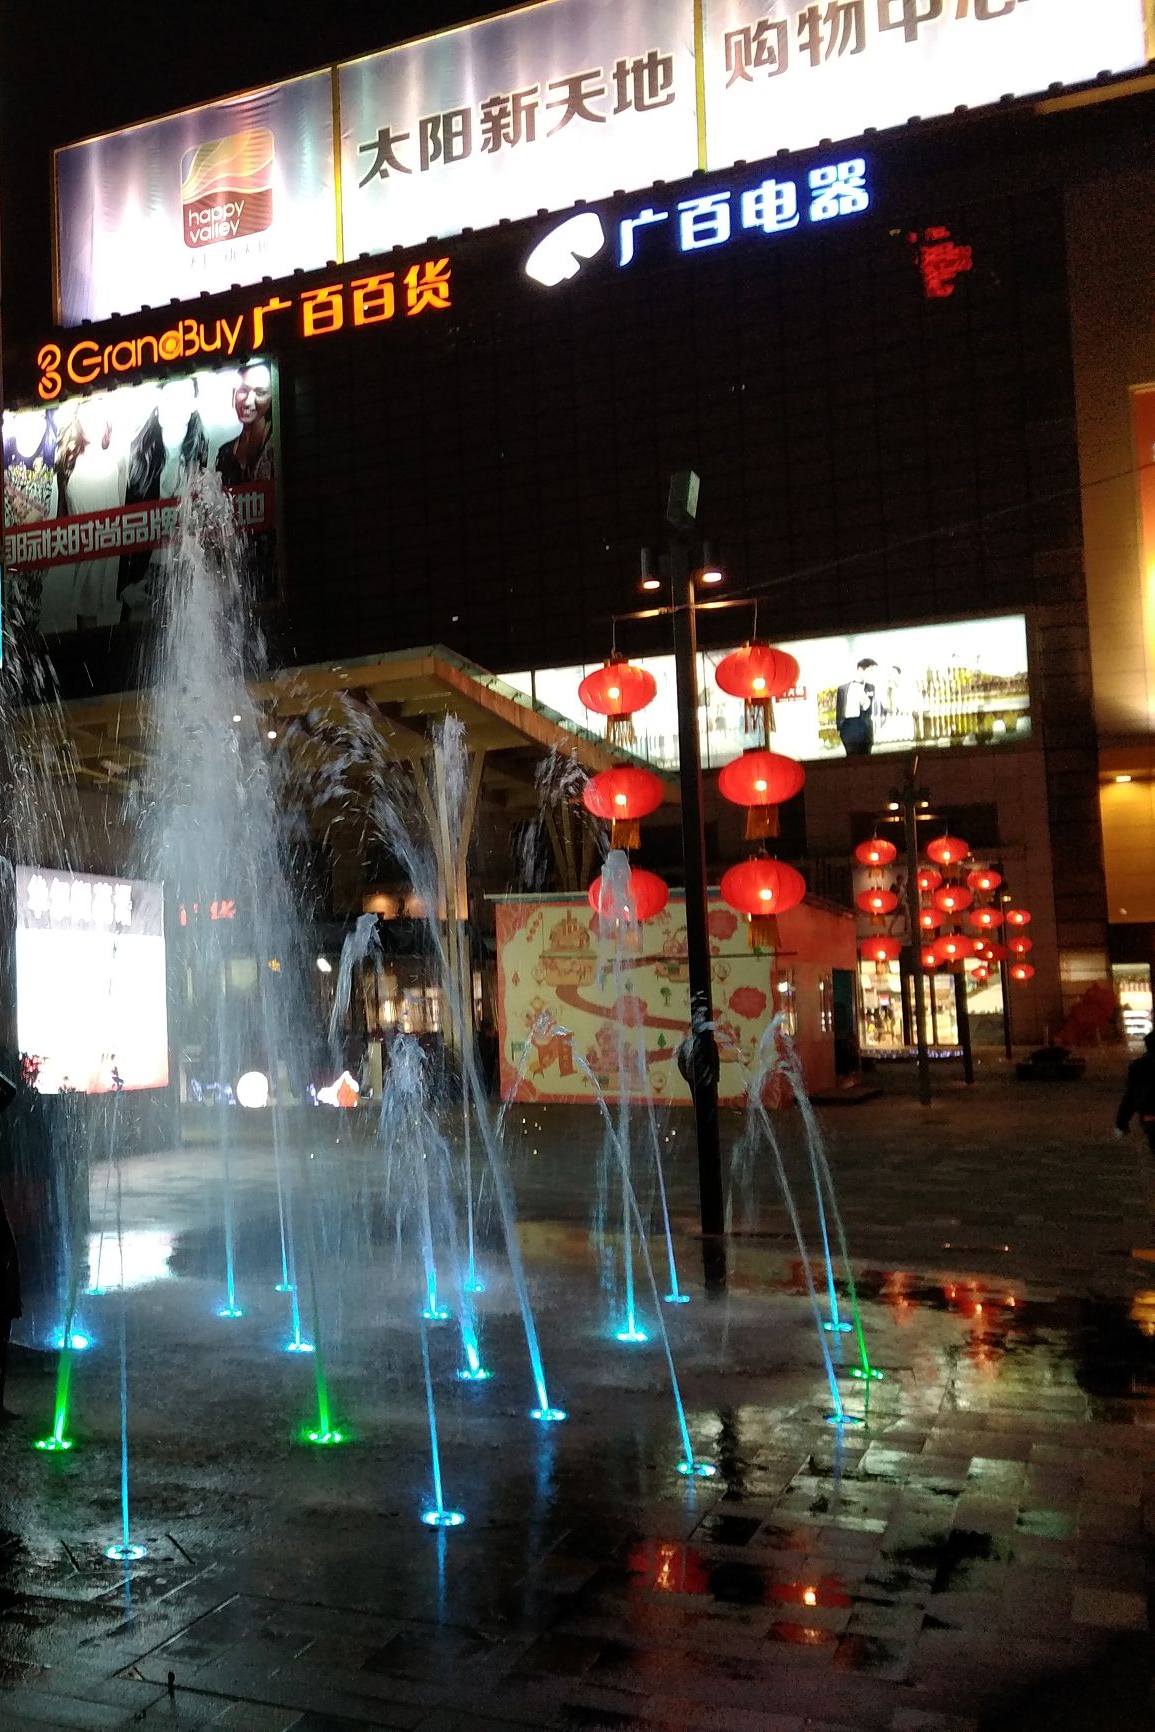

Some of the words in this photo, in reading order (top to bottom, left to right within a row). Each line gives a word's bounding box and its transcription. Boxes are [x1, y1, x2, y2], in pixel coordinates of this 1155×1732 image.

[358, 48, 675, 190] 太阳新天地
[188, 200, 245, 228] happy
[189, 219, 240, 243] valley
[618, 157, 870, 269] 广百电器
[252, 257, 452, 351] 广百百货
[67, 314, 243, 384] GrandBuy
[5, 492, 265, 565] 际快时尚品牌地
